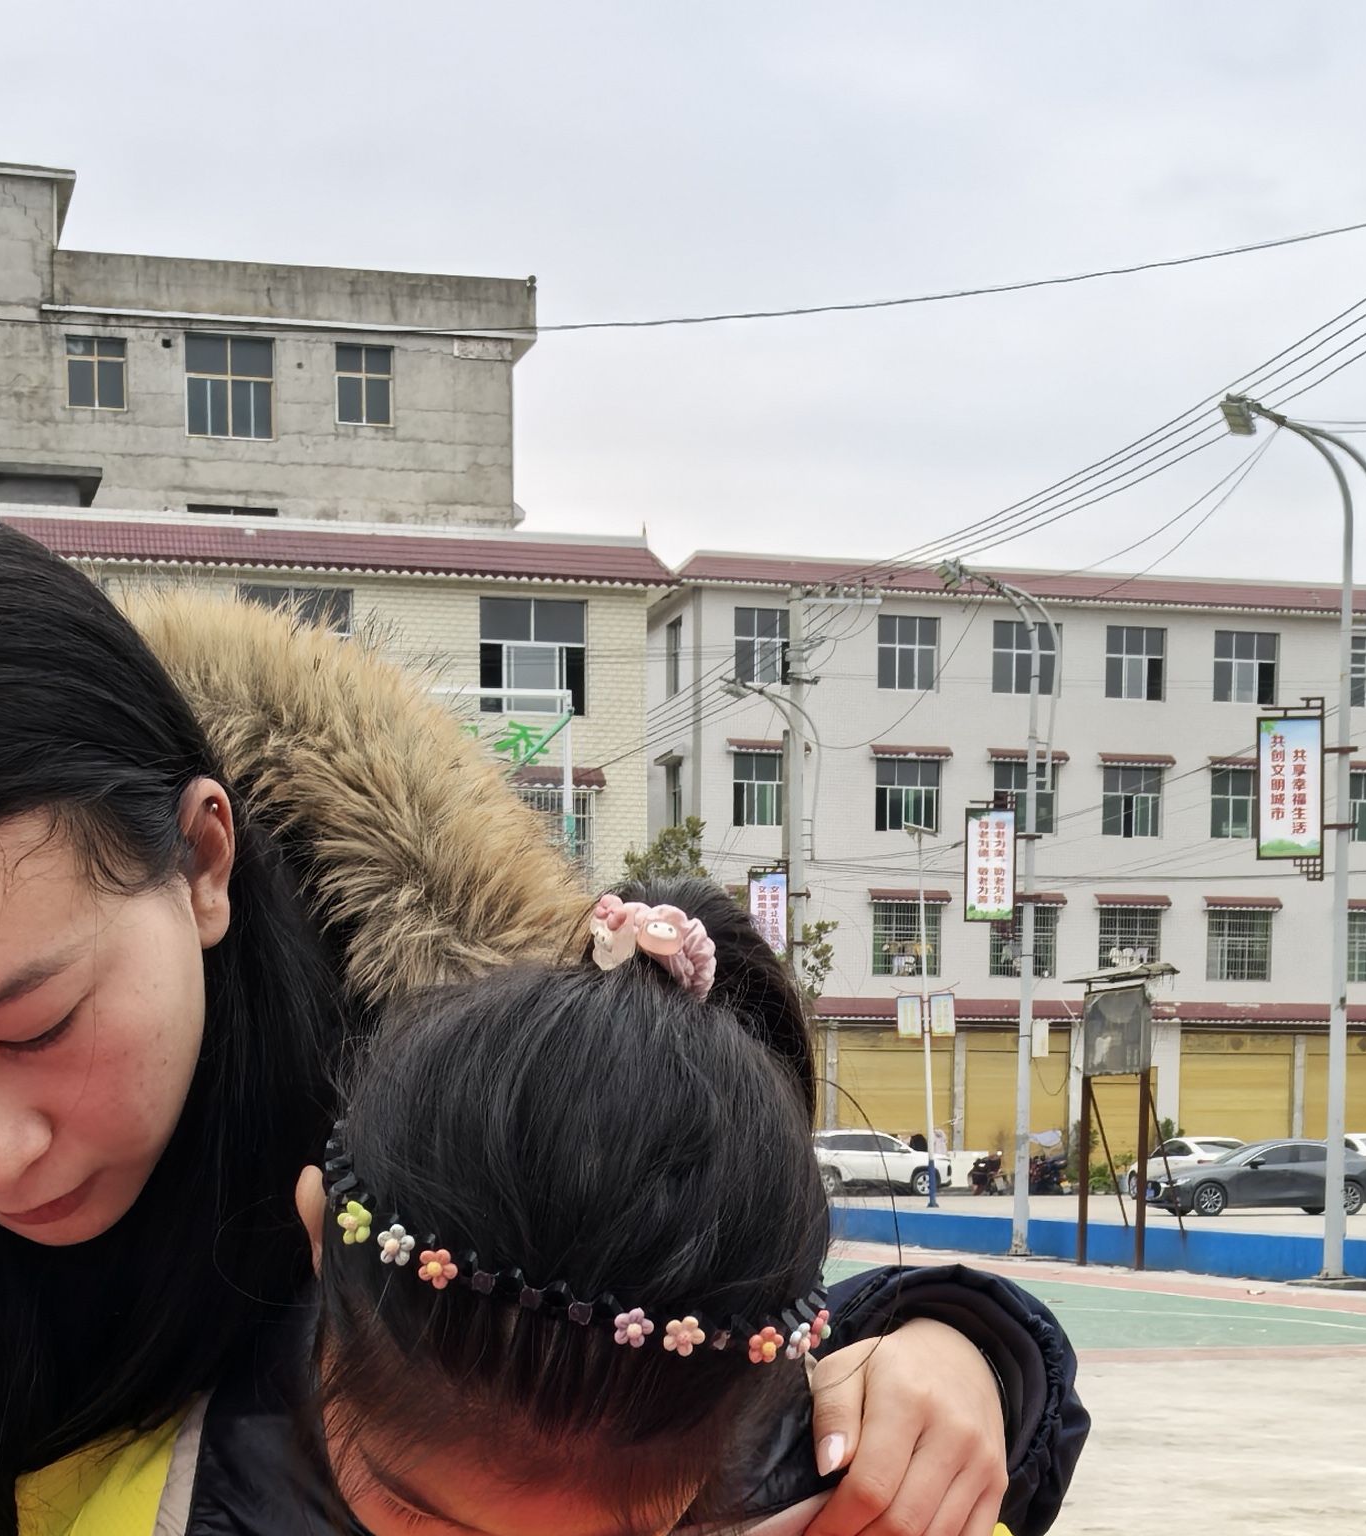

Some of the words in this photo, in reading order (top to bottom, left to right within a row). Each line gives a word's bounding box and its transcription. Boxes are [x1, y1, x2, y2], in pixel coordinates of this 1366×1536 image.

[1270, 734, 1286, 821] 共创文明城市
[1291, 748, 1307, 835] 共享幸福生活
